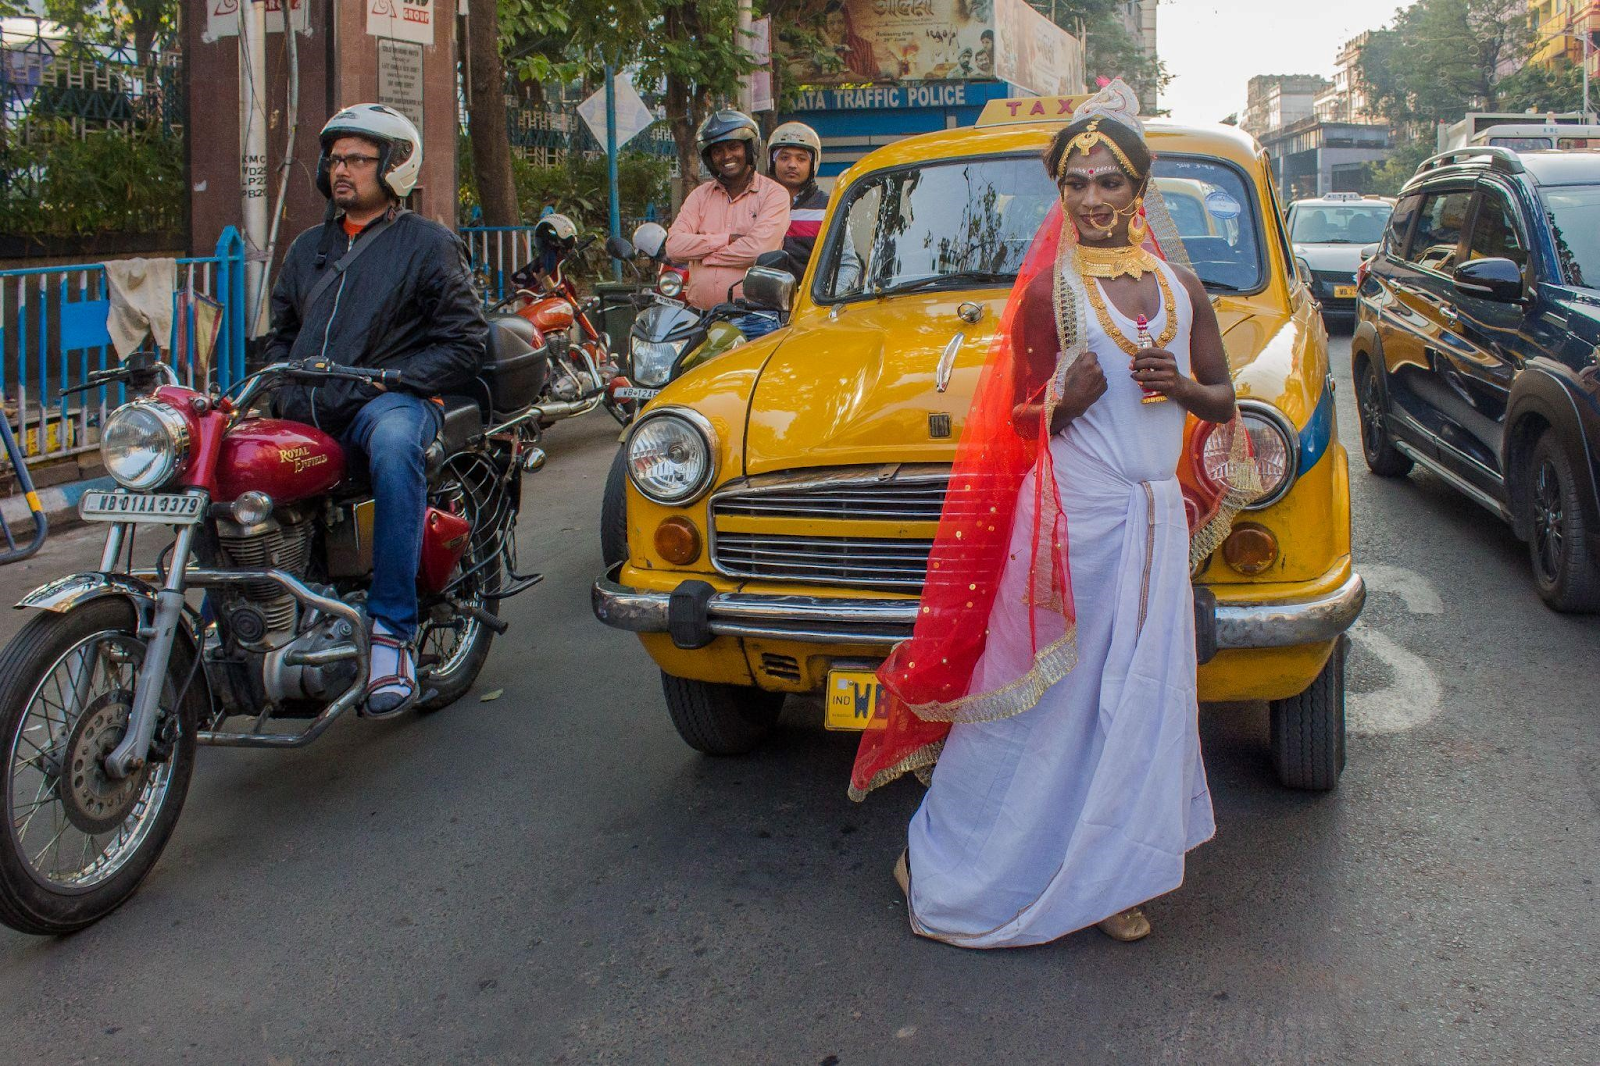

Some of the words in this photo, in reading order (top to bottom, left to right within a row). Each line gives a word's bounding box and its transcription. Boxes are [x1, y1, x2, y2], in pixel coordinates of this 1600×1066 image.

[403, 9, 429, 22] GROUP
[834, 87, 900, 109] TRAFFIC
[908, 85, 966, 107] POLICE
[1006, 99, 1074, 116] TAX
[242, 155, 266, 165] KMC
[278, 446, 310, 463] ROYAL
[160, 497, 198, 513] 3379
[832, 695, 851, 706] IND
